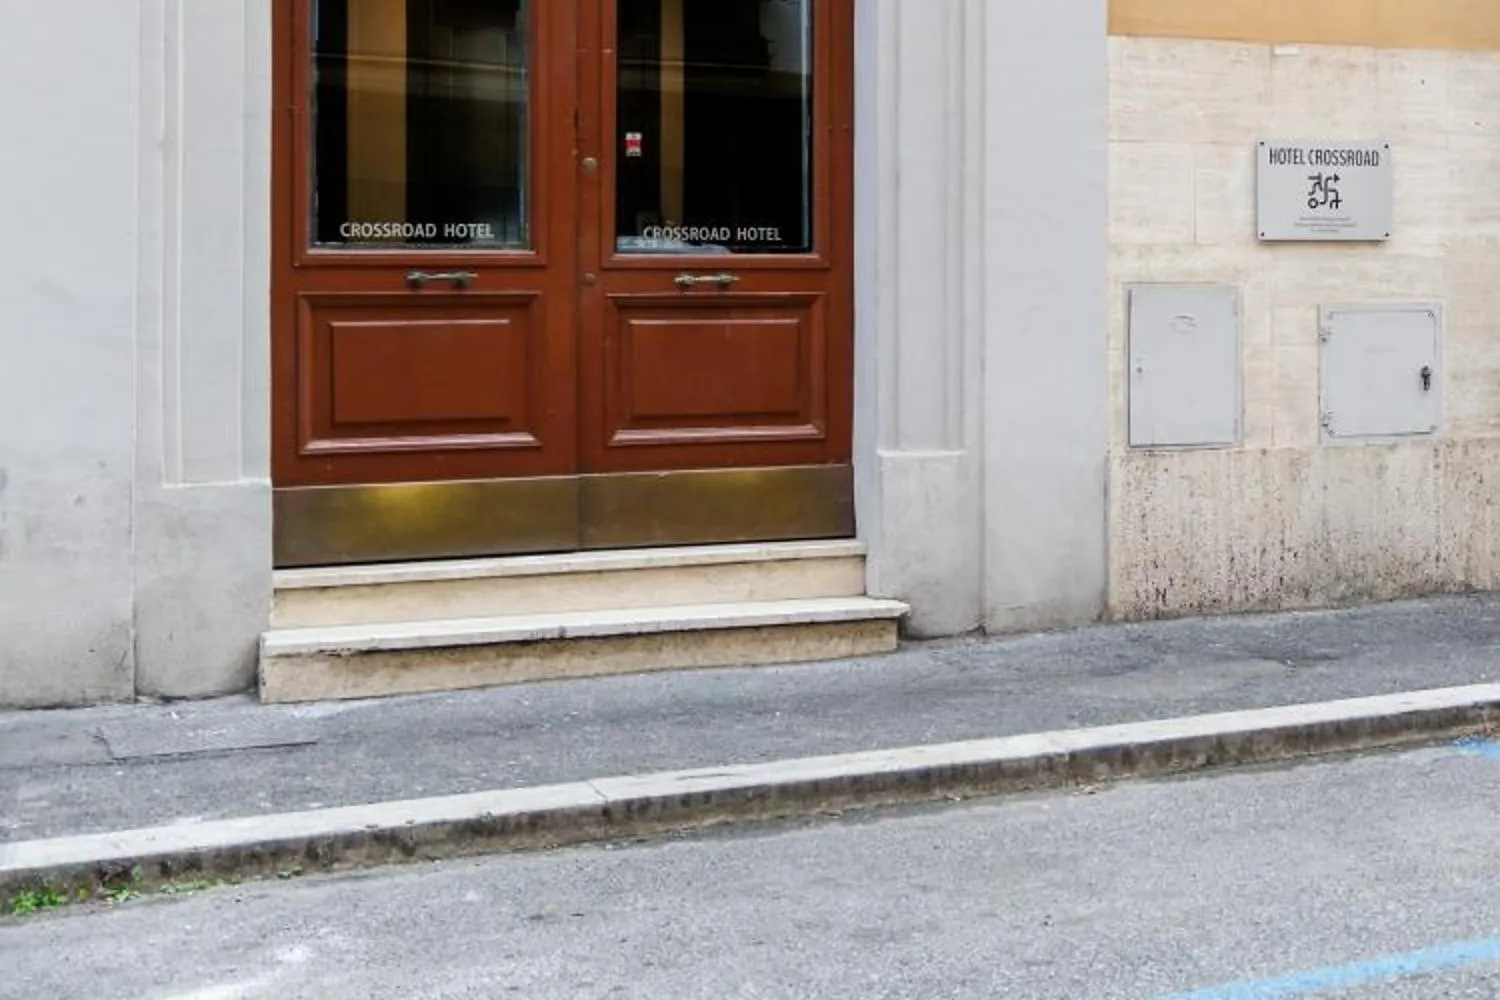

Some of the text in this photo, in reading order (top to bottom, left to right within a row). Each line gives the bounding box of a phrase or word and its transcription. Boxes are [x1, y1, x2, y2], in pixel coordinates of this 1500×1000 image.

[1269, 147, 1380, 167] HOTEL CROSSROAD
[339, 222, 495, 239] CROSSROAD HOTEL
[643, 226, 783, 242] CROSSROAD HOTEL
